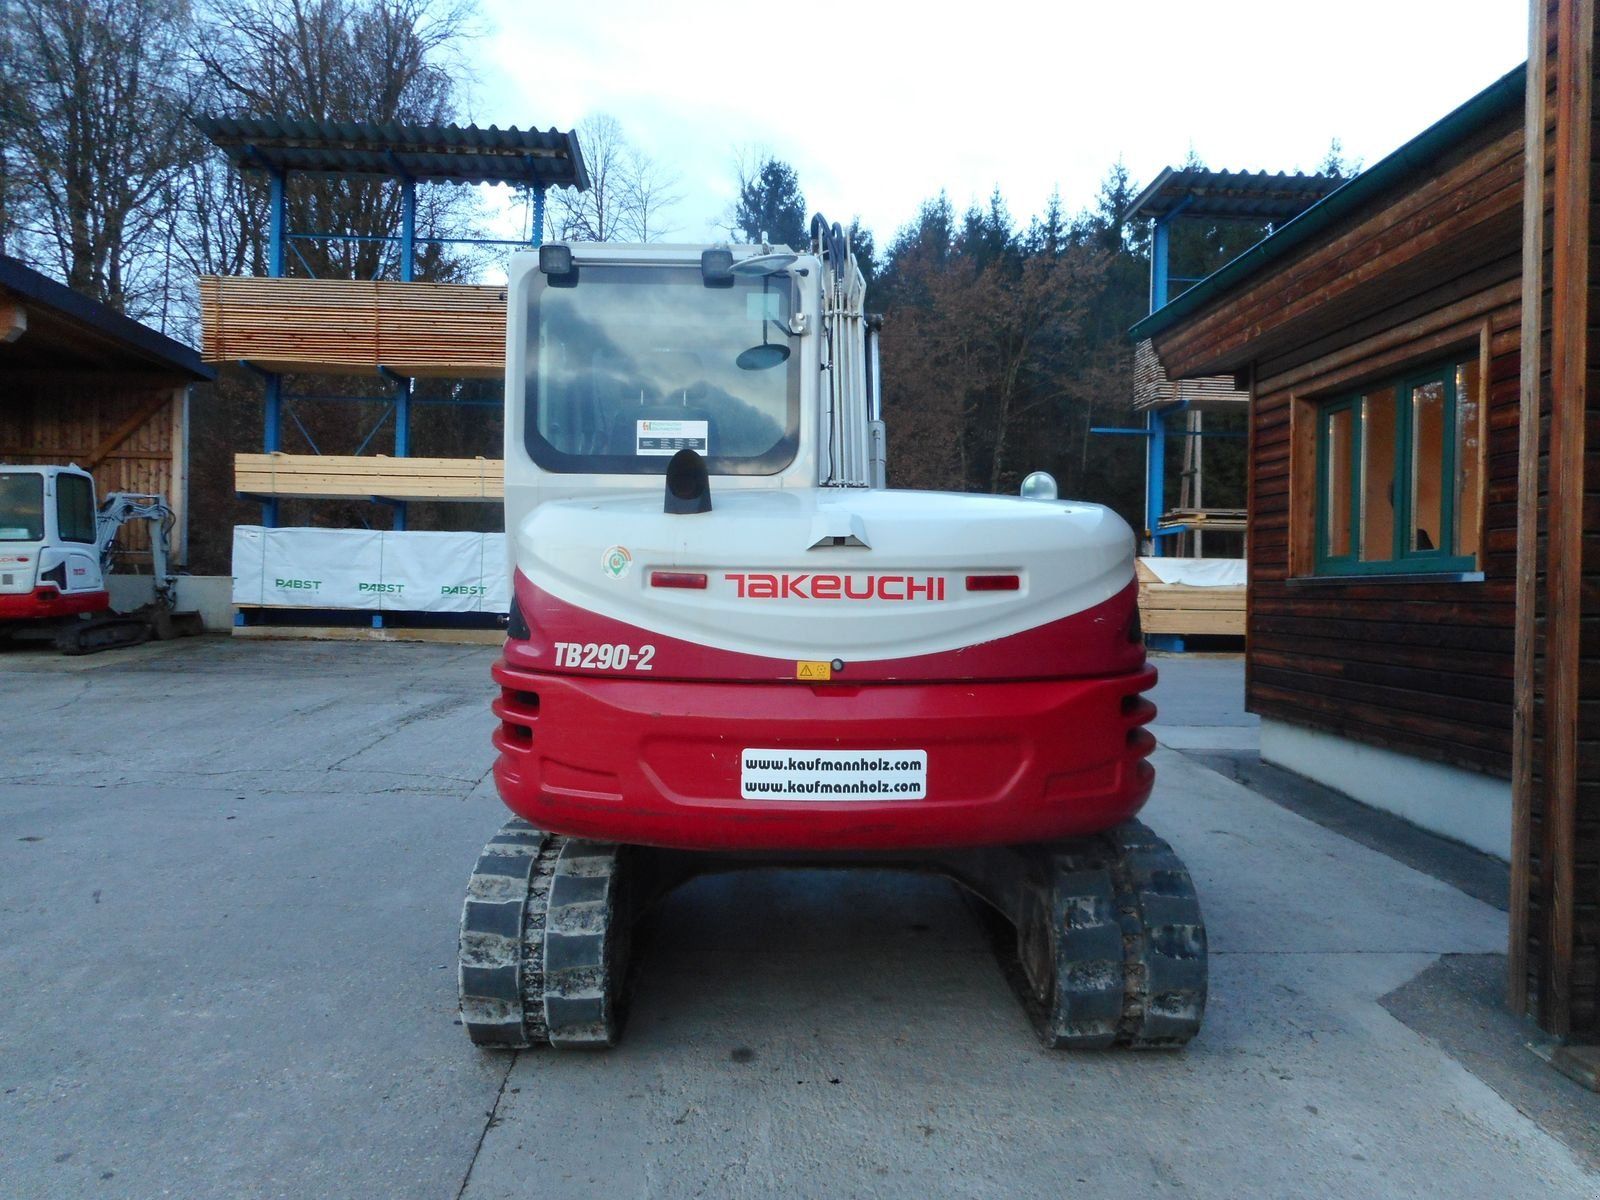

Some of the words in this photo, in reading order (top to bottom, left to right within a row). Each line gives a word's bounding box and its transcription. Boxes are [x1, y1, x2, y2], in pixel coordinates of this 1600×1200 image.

[275, 578, 322, 590] PABST
[359, 582, 405, 593] PABST
[441, 585, 487, 595] PABST
[554, 642, 656, 671] TB290-2
[745, 757, 922, 771] www.kaufmannholz.com
[745, 780, 921, 794] www.kaufmannholz.com
